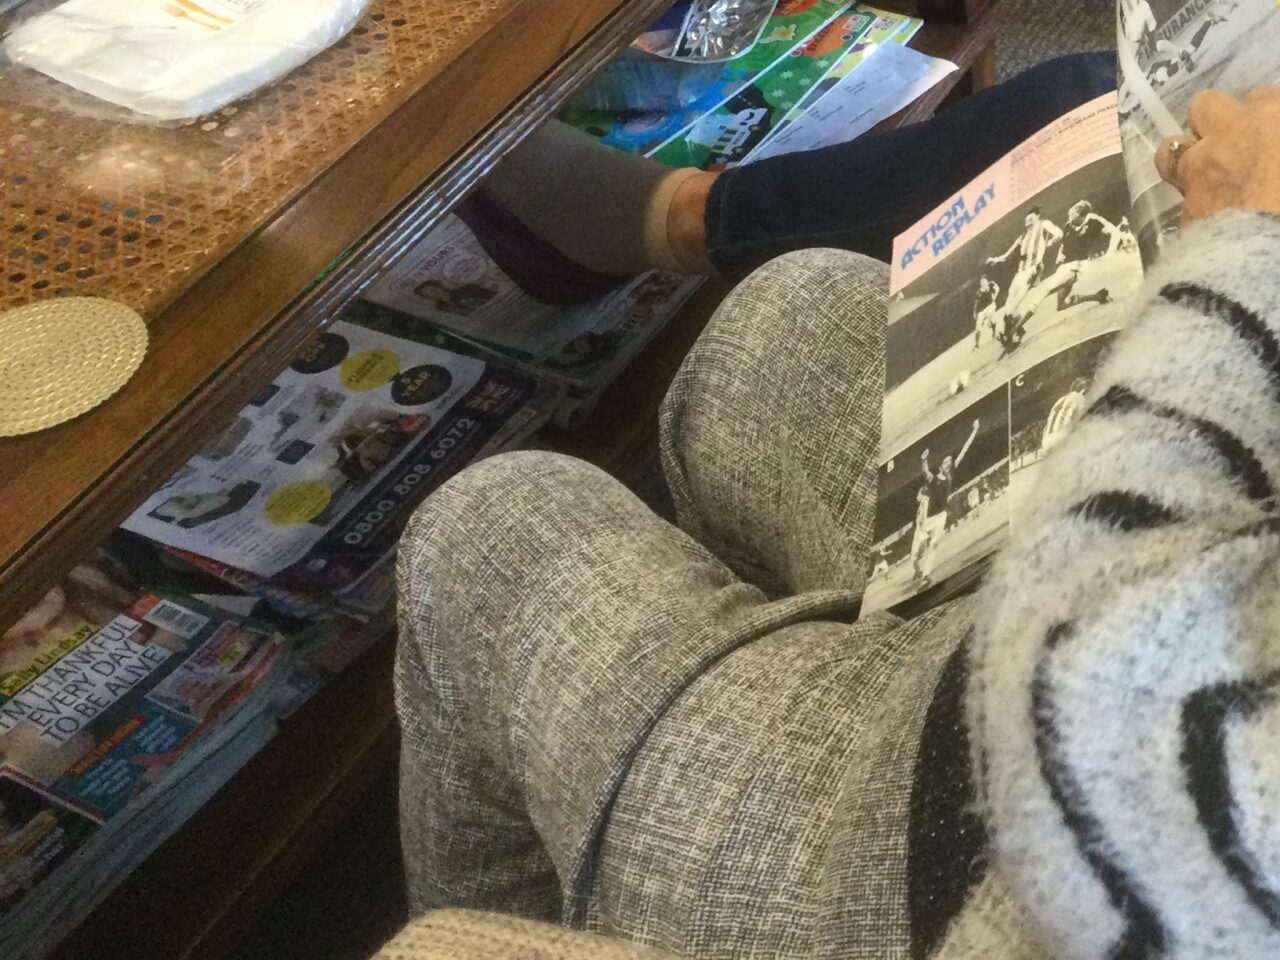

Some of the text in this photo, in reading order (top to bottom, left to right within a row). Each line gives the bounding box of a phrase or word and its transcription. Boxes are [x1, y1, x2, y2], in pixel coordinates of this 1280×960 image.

[901, 196, 965, 270] ACTION
[931, 182, 996, 257] REPLAY
[1015, 373, 1025, 387] C
[344, 499, 395, 544] 0800
[394, 464, 432, 495] 808
[430, 418, 476, 459] 6072
[21, 621, 139, 699] THANKFUL
[27, 672, 96, 727] EVERY
[91, 640, 138, 677] DAY
[41, 716, 80, 742] TO
[74, 694, 110, 719] BE
